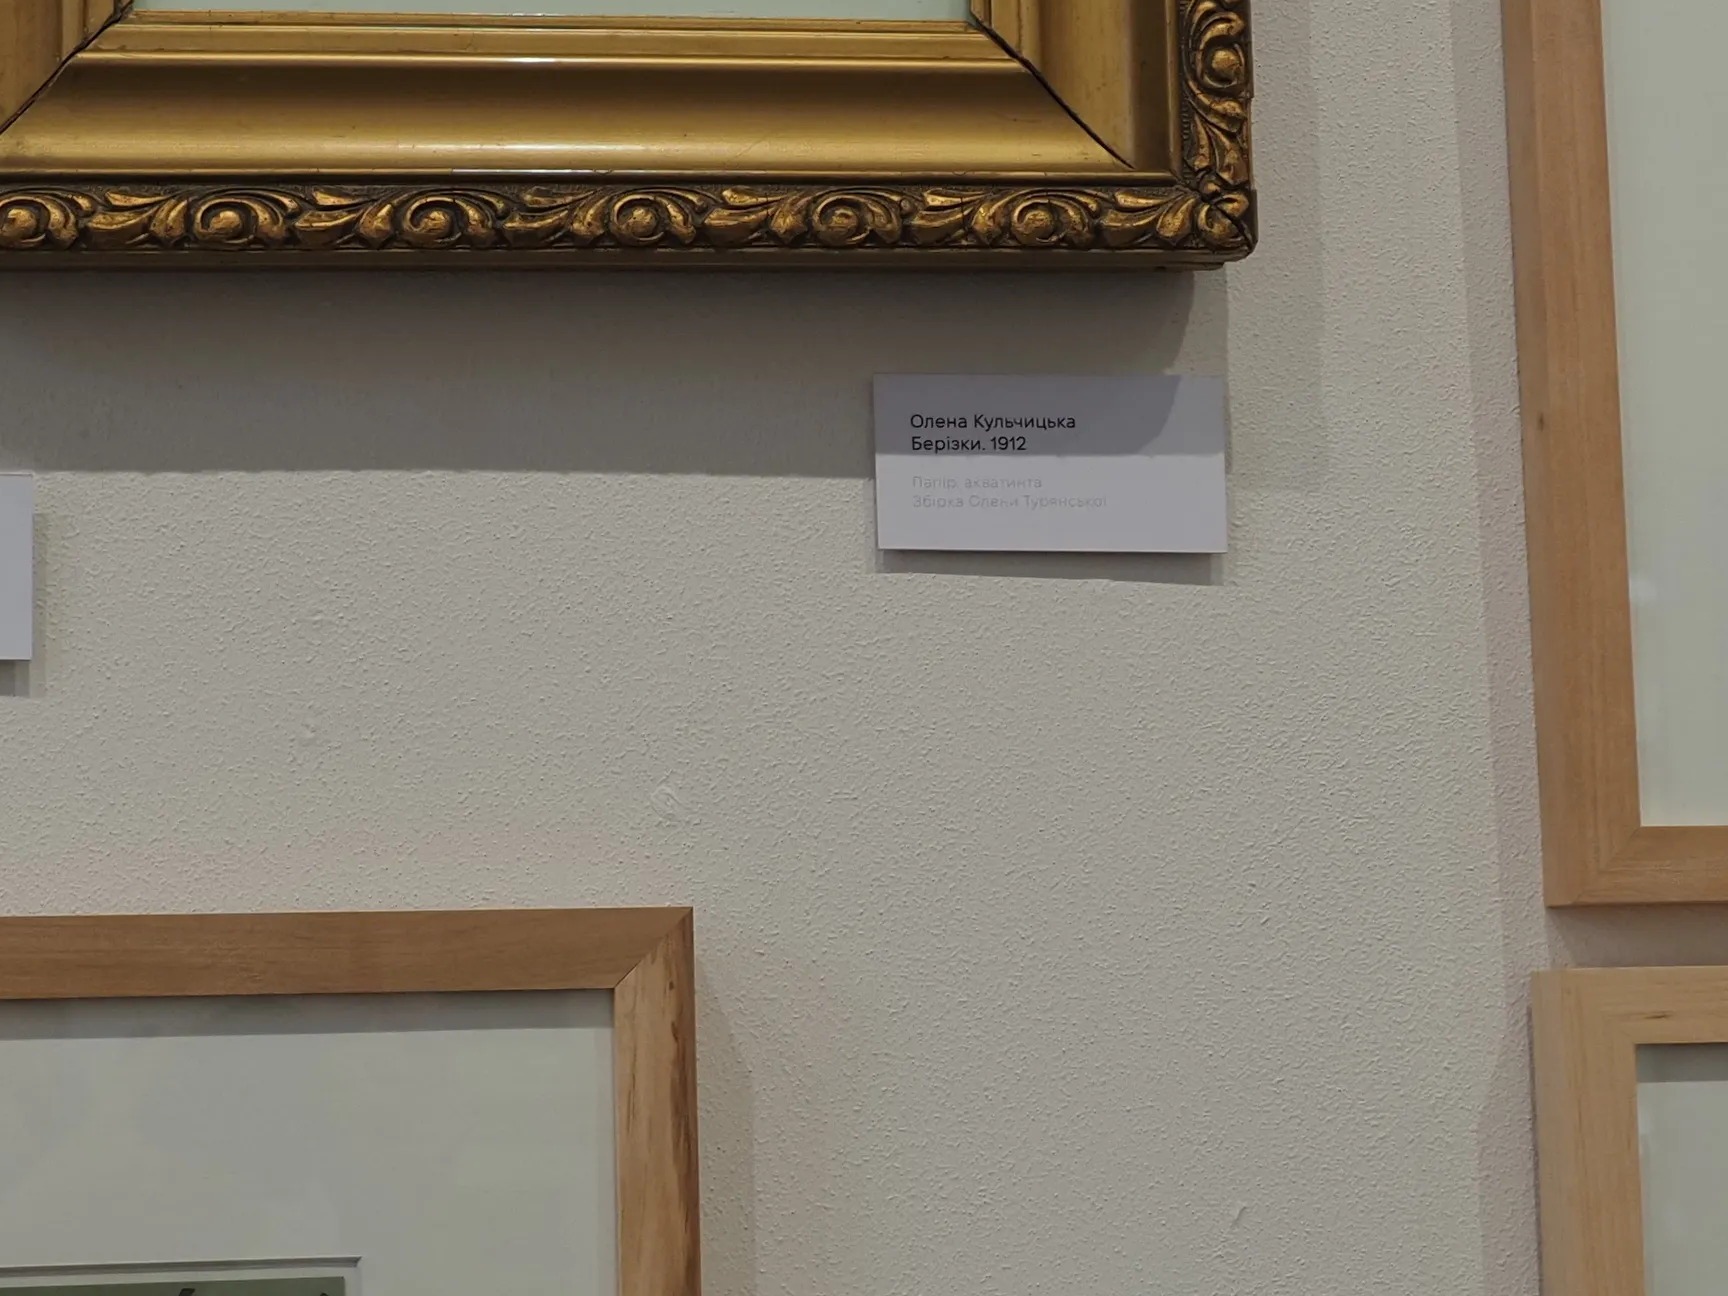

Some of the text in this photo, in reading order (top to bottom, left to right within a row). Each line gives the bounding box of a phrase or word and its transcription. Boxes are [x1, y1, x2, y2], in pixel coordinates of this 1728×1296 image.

[910, 414, 1076, 432] Олена Кульчицька
[910, 436, 1028, 453] Берізки. 1912
